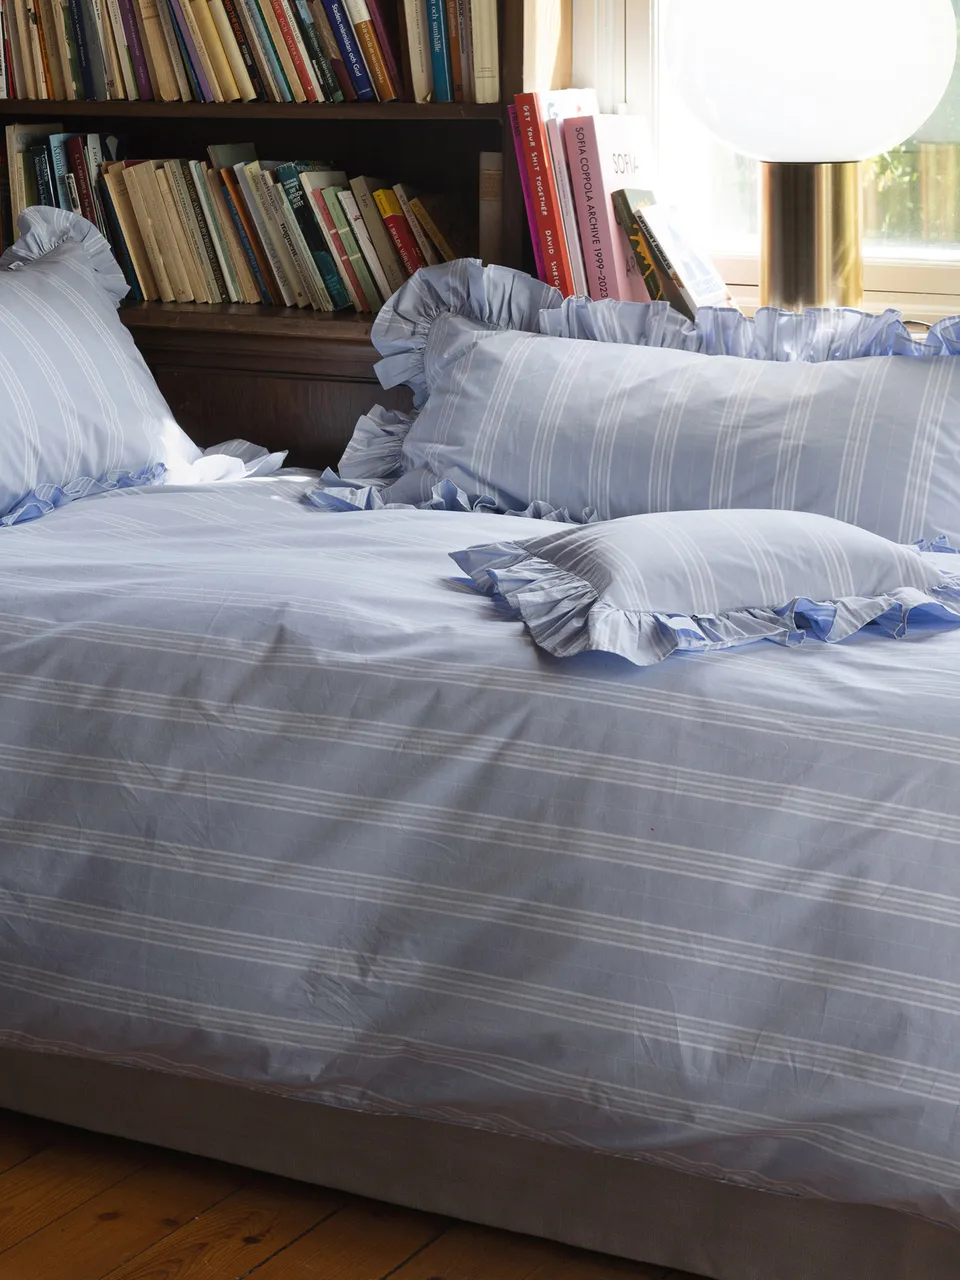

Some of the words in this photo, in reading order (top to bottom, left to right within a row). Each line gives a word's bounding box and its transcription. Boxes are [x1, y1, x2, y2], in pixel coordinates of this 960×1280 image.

[228, 10, 237, 23] THE
[330, 2, 343, 24] Staden,
[232, 21, 244, 44] BEAST
[278, 17, 288, 32] OCH
[285, 34, 300, 65] ORTERNA
[337, 22, 353, 52] människan
[432, 21, 441, 52] samhälle
[348, 51, 357, 63] och
[352, 63, 362, 77] Gud
[522, 105, 532, 121] GET
[526, 126, 536, 147] YOUR
[574, 127, 587, 155] SOFIA
[531, 151, 541, 171] SHIT
[580, 157, 593, 202] COPPOLA
[535, 176, 548, 216] TOGETHER
[588, 205, 601, 245] ARCHIVE
[203, 235, 214, 258] FRIENDS
[278, 222, 297, 257] fragment
[389, 227, 403, 248] SKILDA
[545, 230, 555, 254] DAVID
[636, 215, 655, 244] ANTHONY
[653, 244, 672, 270] BURGESS
[594, 248, 609, 298] 1999–2023
